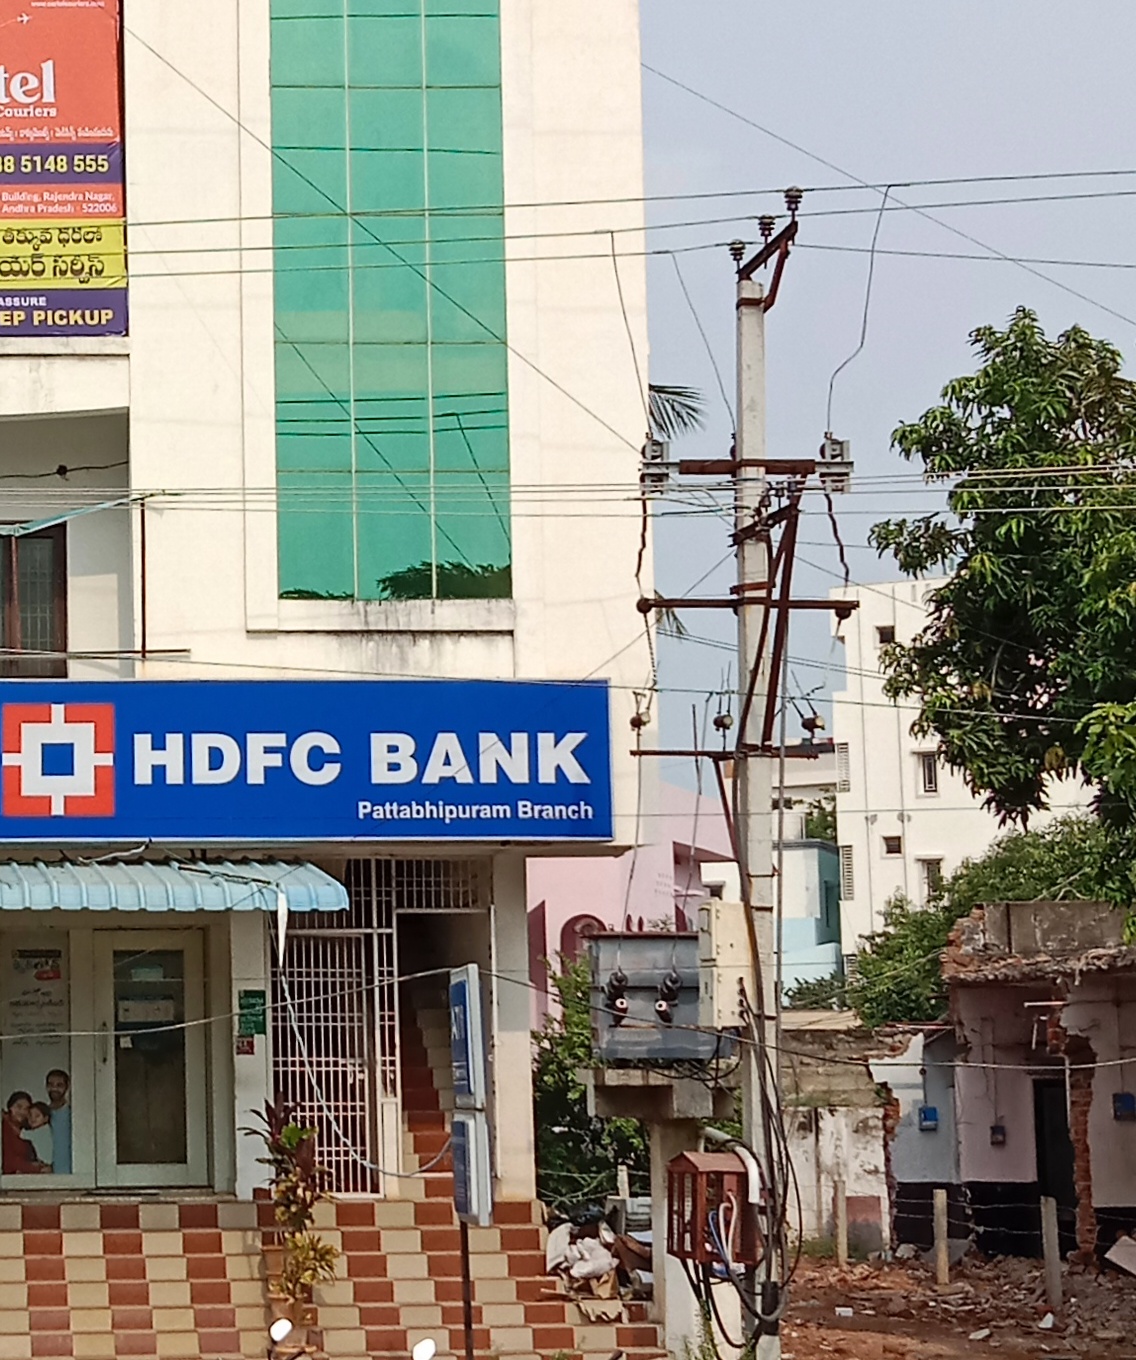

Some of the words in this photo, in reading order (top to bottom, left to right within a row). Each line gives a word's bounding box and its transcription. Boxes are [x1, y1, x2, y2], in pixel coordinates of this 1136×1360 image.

[21, 155, 67, 173] 5148
[73, 154, 109, 173] 555
[43, 191, 83, 204] Rajendra
[2, 203, 35, 214] Andhra
[37, 203, 74, 214] Pradesh
[33, 309, 114, 326] PICKUP
[133, 732, 342, 786] HDFC
[370, 732, 592, 785] BANK
[358, 801, 512, 824] Pattabhipuram
[517, 801, 594, 820] Branch
